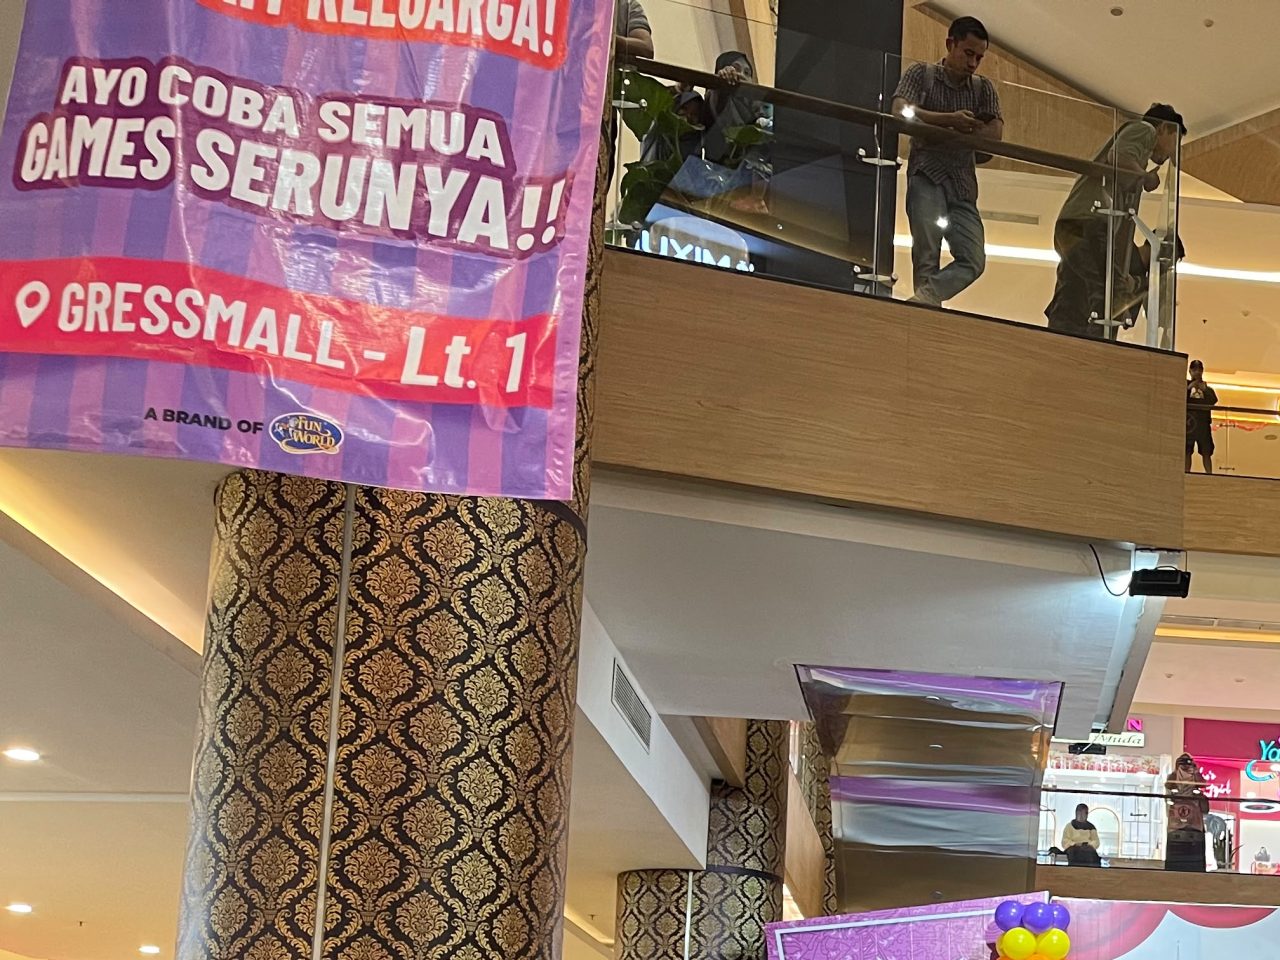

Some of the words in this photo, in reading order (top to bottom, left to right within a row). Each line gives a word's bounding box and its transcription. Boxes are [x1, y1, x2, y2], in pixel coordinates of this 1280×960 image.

[61, 65, 147, 108] AYO
[159, 65, 299, 136] COBA
[318, 101, 505, 168] SEMUA
[20, 116, 174, 183] GAMES
[190, 129, 562, 251] SERUNYA!!
[58, 282, 345, 370] GRESSMALL
[400, 325, 477, 390] Lt.
[505, 331, 528, 394] 1
[144, 407, 157, 420] A
[163, 408, 232, 430] BRAND
[237, 419, 264, 434] OF
